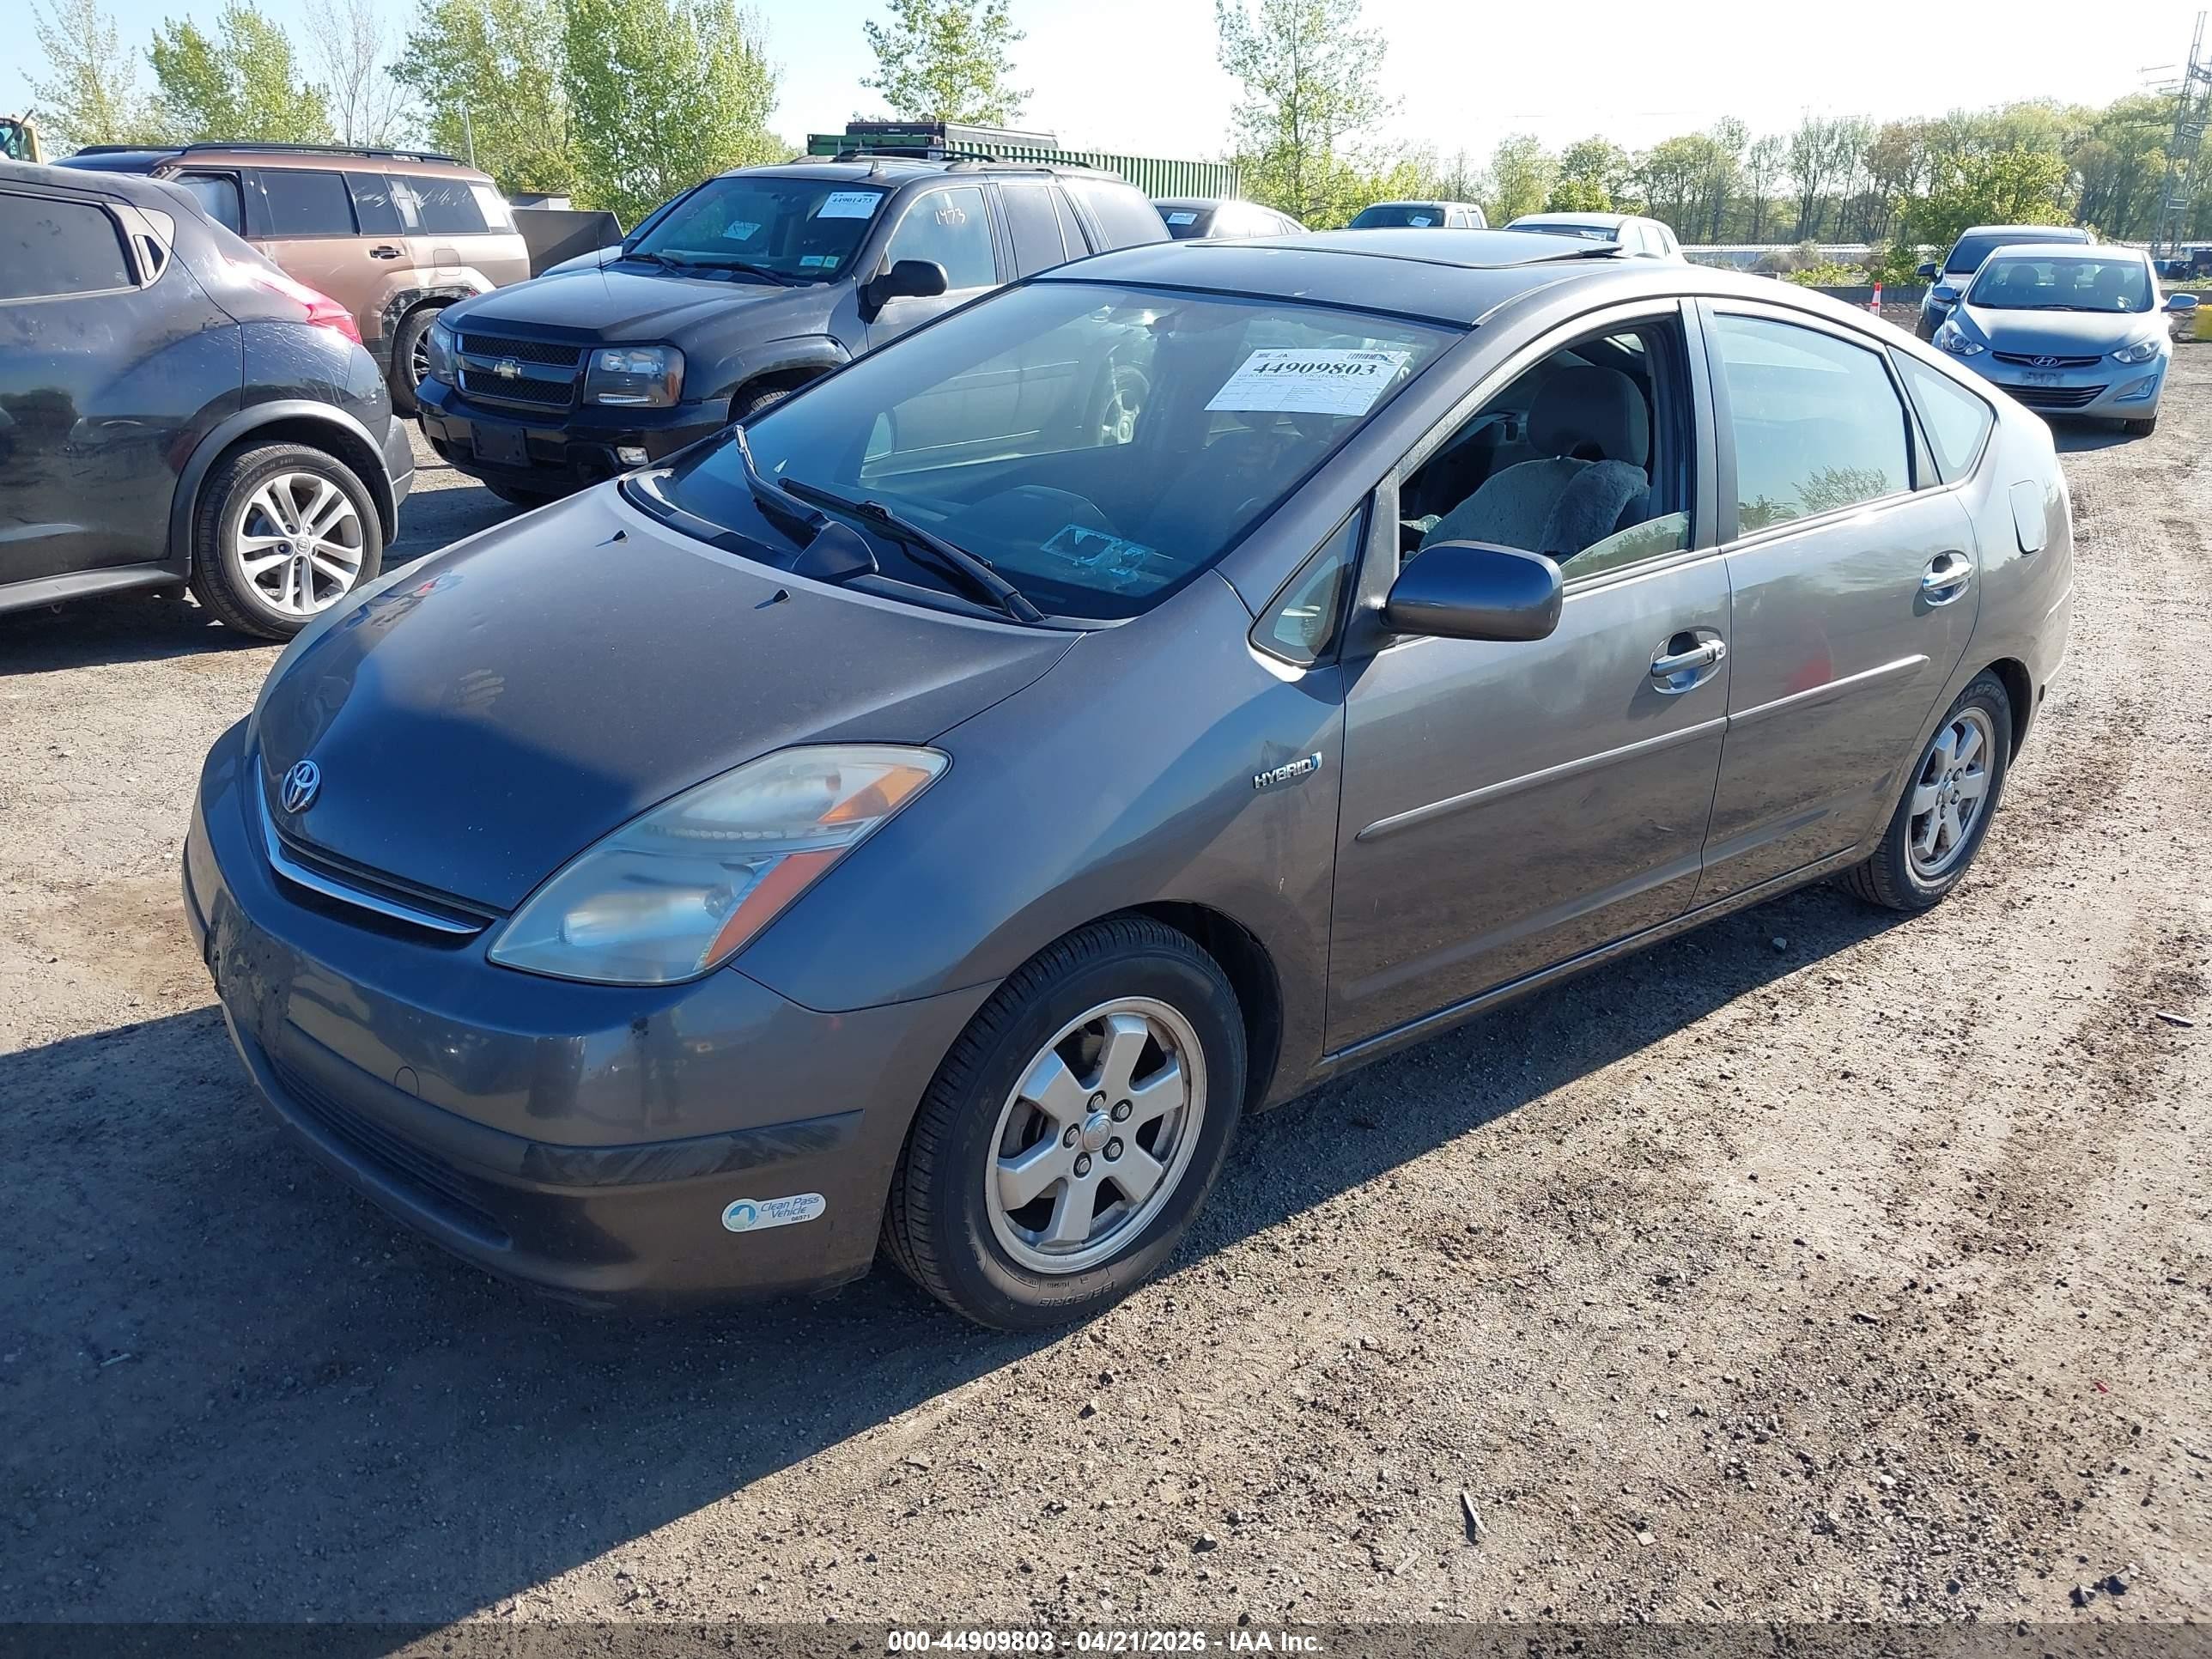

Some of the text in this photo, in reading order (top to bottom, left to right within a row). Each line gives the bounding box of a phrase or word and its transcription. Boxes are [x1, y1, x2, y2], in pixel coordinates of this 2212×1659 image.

[934, 207, 966, 226] 1473
[1253, 362, 1377, 376] 44909803
[1253, 758, 1313, 789] HYBRID
[761, 1196, 820, 1212] Clean Pass
[771, 1206, 807, 1218] Vehicle
